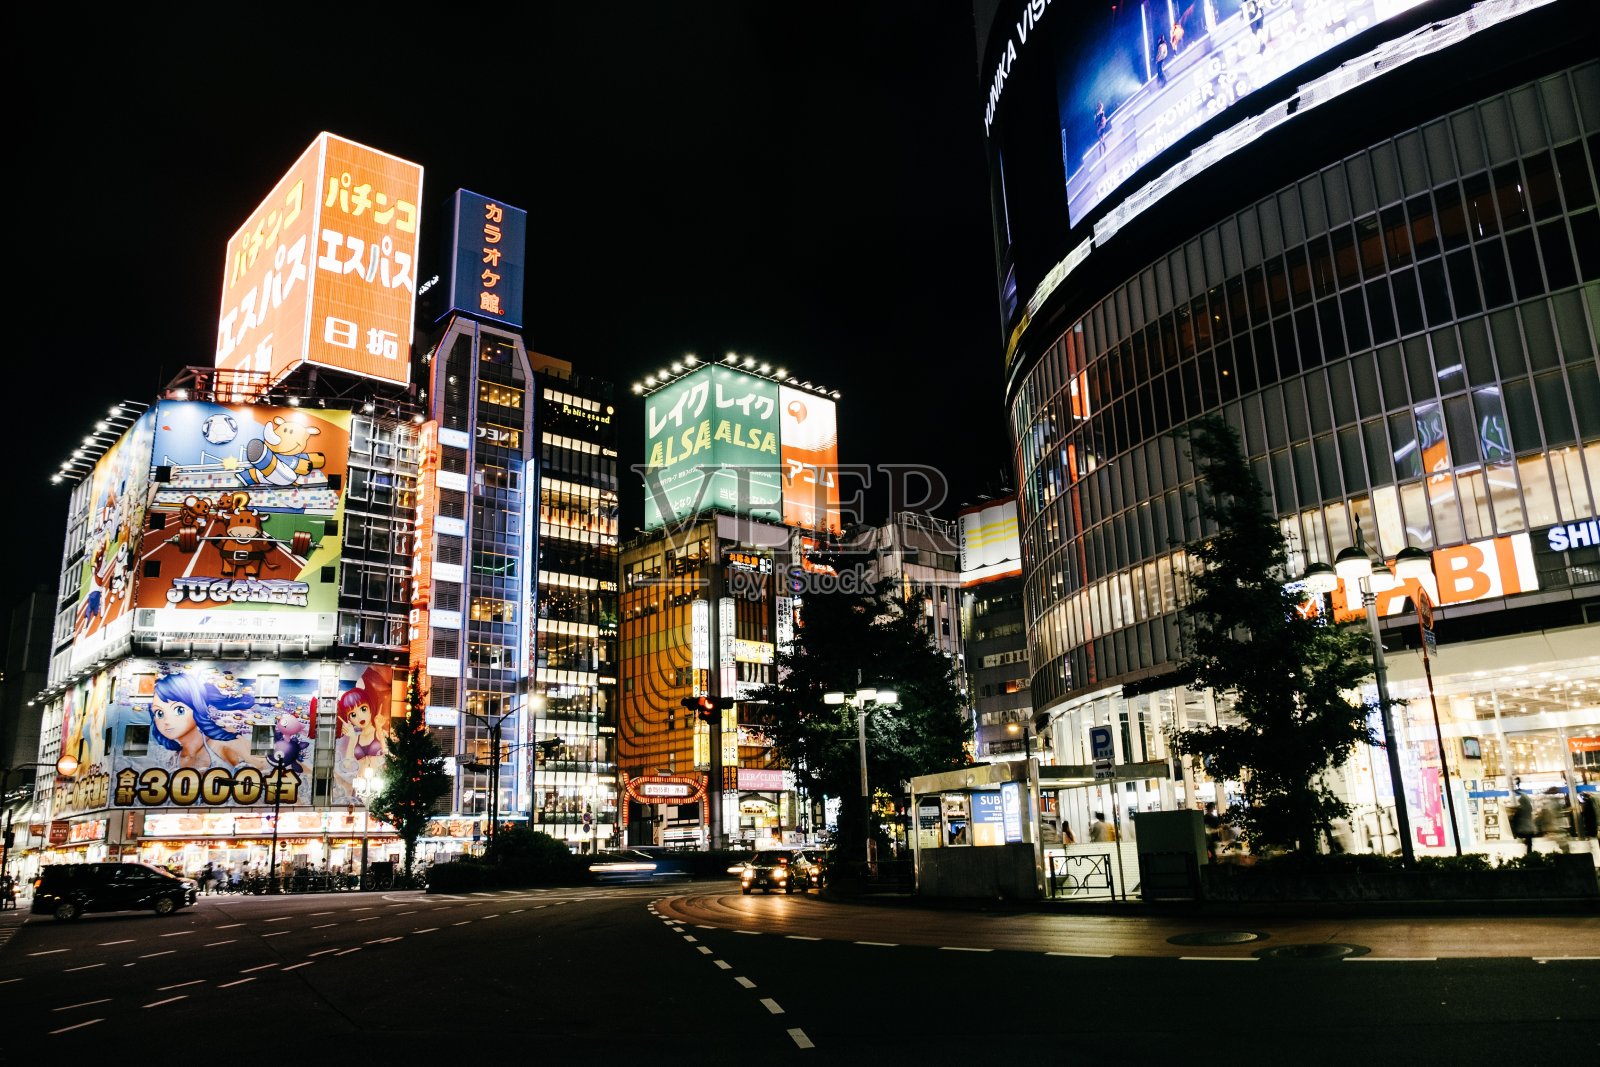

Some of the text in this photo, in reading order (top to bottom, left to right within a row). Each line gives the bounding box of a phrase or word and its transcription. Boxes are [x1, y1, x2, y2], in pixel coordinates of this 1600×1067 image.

[985, 0, 1052, 137] YUNIKA VIS
[325, 172, 417, 234] パチンコ
[230, 178, 304, 289] パチンコ
[318, 228, 413, 293] エスパス
[479, 203, 504, 314] カラオケ館
[215, 234, 307, 362] エスパス
[324, 315, 399, 360] 日拓
[562, 404, 587, 418] Public
[649, 380, 710, 439] レイク
[715, 383, 775, 420] レイク
[646, 419, 712, 475] ALSA
[714, 419, 777, 455] ALSA
[787, 458, 835, 489] アコム
[411, 504, 424, 602] エスパス
[1547, 521, 1600, 551] SHI
[166, 577, 309, 607] JUGGLER
